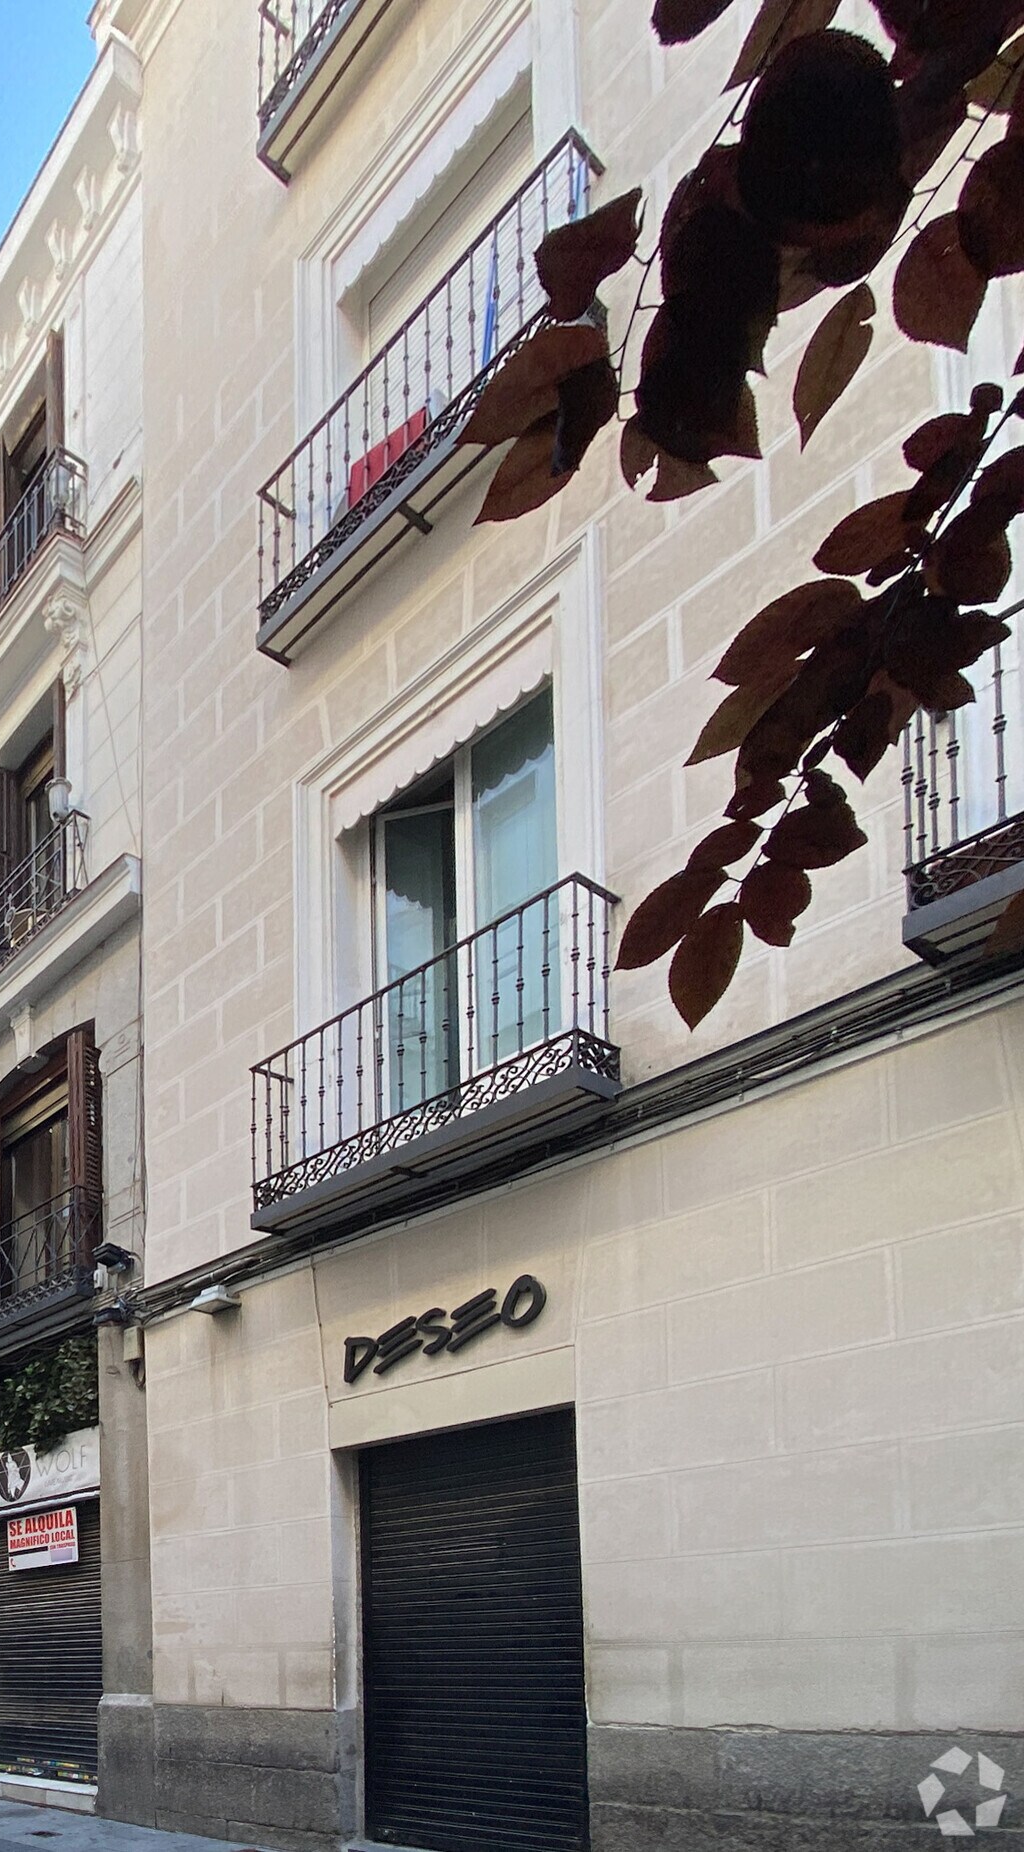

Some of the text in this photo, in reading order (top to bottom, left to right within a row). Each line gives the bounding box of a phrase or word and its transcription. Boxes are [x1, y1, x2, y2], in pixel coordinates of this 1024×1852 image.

[344, 1274, 547, 1383] DESEO
[35, 1444, 87, 1477] WOLF
[9, 1510, 74, 1537] SE ALQUILA
[9, 1529, 75, 1549] MAGNIFICO LOCAL
